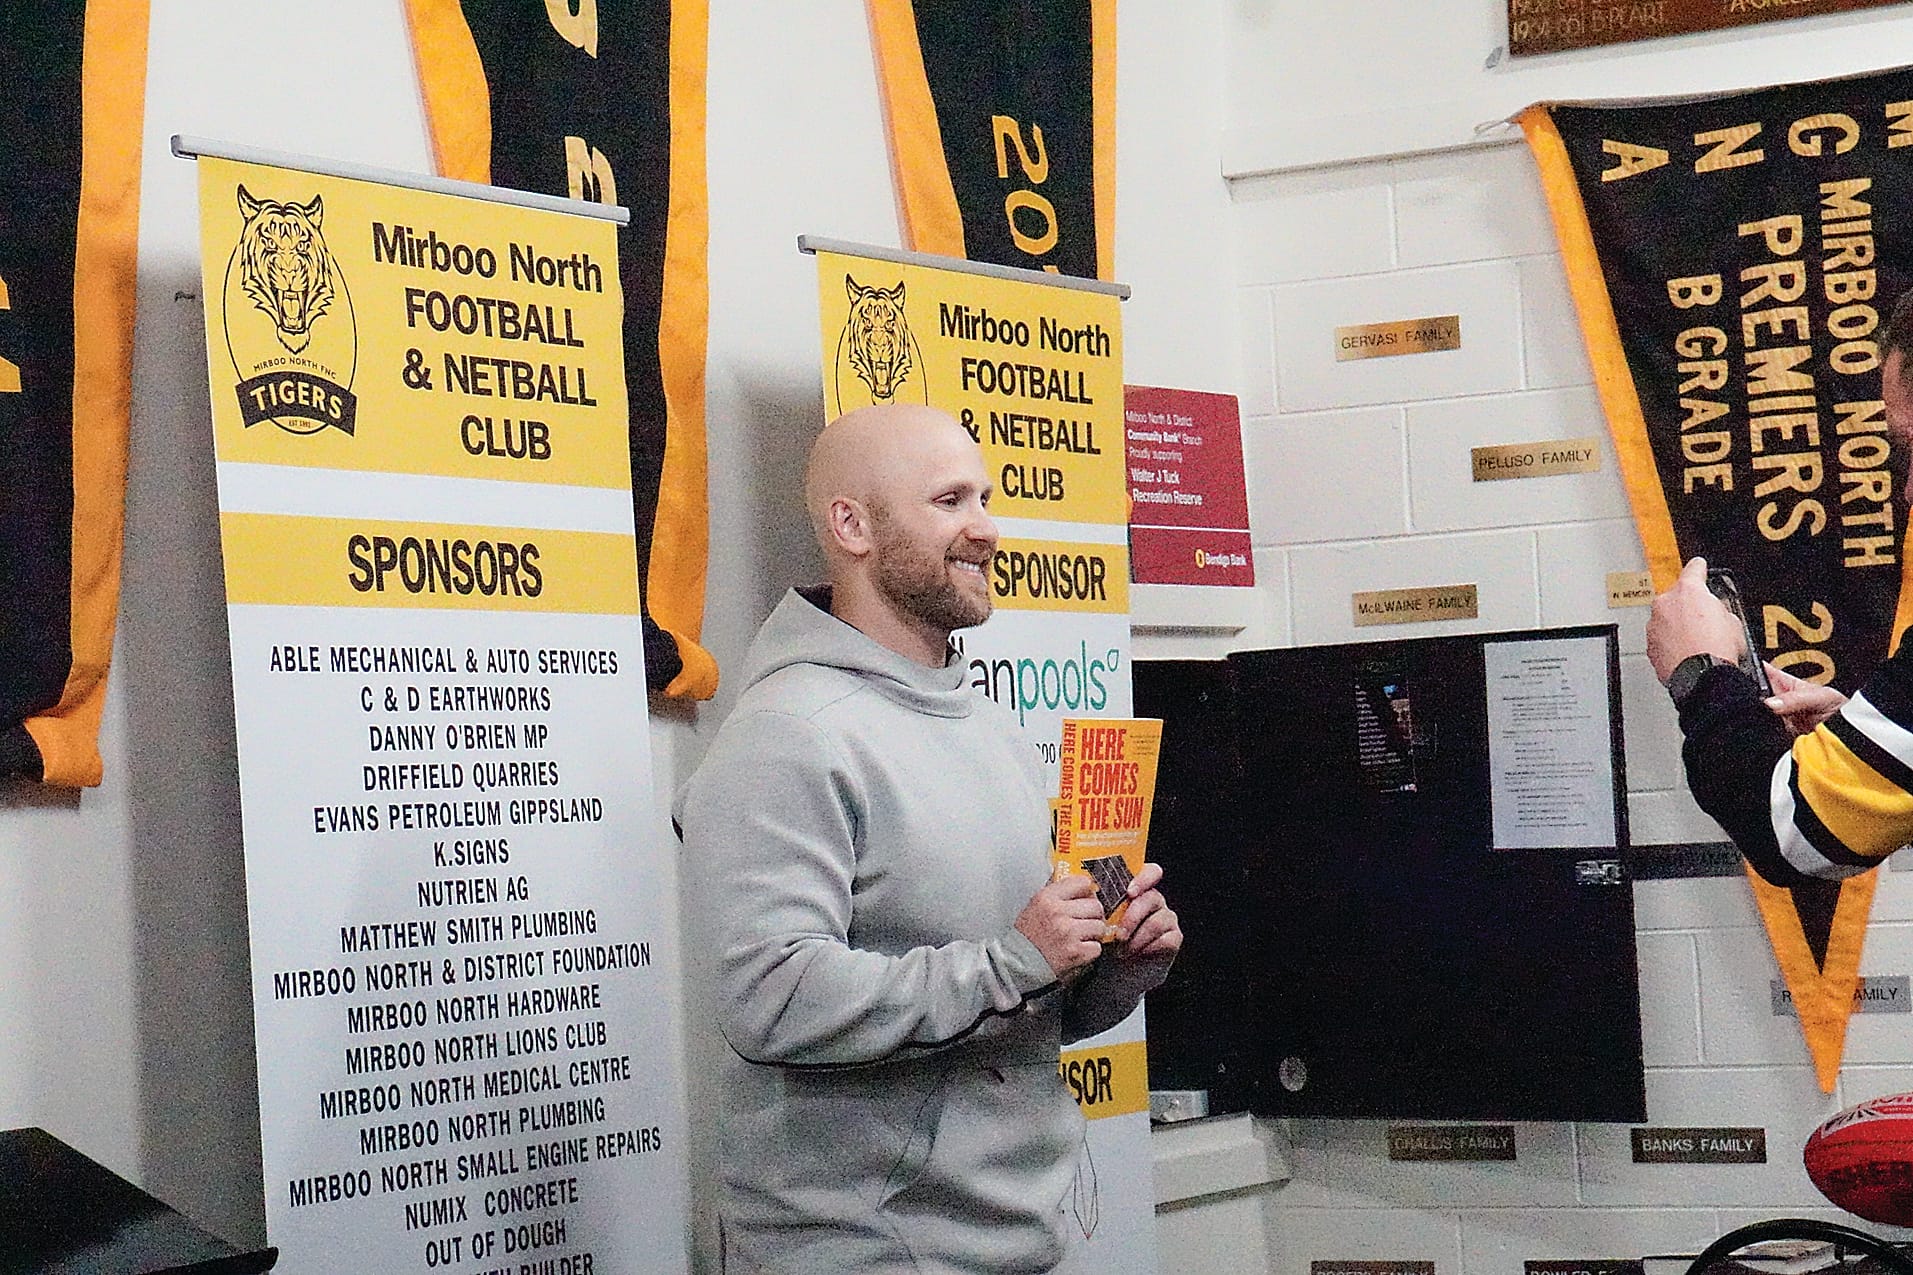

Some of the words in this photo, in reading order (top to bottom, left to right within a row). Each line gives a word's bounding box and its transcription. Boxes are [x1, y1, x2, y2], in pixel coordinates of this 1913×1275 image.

[1694, 122, 1765, 174] N
[1788, 112, 1860, 157] G
[1601, 139, 1670, 183] A
[991, 114, 1061, 273] 20
[372, 221, 498, 279] Mirboo
[510, 242, 603, 293] North
[1818, 178, 1880, 375] MIRBOO
[1667, 273, 1723, 310] B
[405, 287, 584, 348] FOOTBALL
[938, 302, 1030, 348] Mirboo
[1039, 316, 1110, 358] North
[1341, 333, 1398, 350] GERVASI
[1405, 328, 1453, 344] FAMILY
[253, 357, 286, 372] MIRBOO
[290, 357, 318, 370] NORTH
[321, 365, 337, 379] FNC
[402, 348, 433, 390] &
[444, 353, 597, 407] NETBALL
[961, 357, 1093, 405] FOOTBALL
[1737, 215, 1828, 542] PREMIERS
[249, 380, 343, 419] TIGERS
[1674, 326, 1735, 494] GRADE
[460, 415, 551, 460] CLUB
[960, 409, 980, 443] &
[990, 410, 1101, 455] NETBALL
[1127, 429, 1162, 444] Community
[1131, 468, 1154, 484] Walter
[1156, 469, 1162, 482] J
[1164, 470, 1180, 485] Tuck
[1479, 454, 1534, 470] PELUSO
[1542, 448, 1593, 466] FAMILY
[1001, 463, 1064, 502] CLUB
[1132, 488, 1173, 504] Recreation
[1174, 490, 1203, 507] Reserve
[1833, 400, 1897, 568] NORTH
[348, 533, 543, 599] SPONSORS
[993, 549, 1107, 601] SPONSOR
[1205, 553, 1230, 567] Bendigo
[1231, 554, 1247, 567] Bank
[1358, 599, 1423, 615] McILWAINE
[1429, 595, 1472, 610] FAMILY
[270, 645, 321, 673] ABLE
[330, 646, 457, 673] MECHANICAL
[466, 649, 479, 673] &
[486, 649, 530, 674] AUTO
[538, 650, 619, 675] SERVICES
[361, 686, 373, 712] C
[384, 686, 399, 712] &
[408, 686, 420, 712] D
[430, 686, 551, 712] EARTHWORKS
[369, 725, 436, 752] DANNY
[446, 725, 517, 751] O'BRIEN
[524, 724, 549, 749] MP
[1064, 723, 1077, 756] HERE
[1081, 728, 1127, 761] HERE
[363, 763, 464, 792] DRIFFIELD
[473, 761, 560, 790] QUARRIES
[1061, 758, 1077, 800] COMES
[1079, 762, 1139, 796] COMES
[313, 806, 379, 834] EVANS
[389, 800, 502, 831] PETROLEUM
[509, 798, 603, 826] GIPPSLAND
[1059, 803, 1073, 826] THE
[1078, 798, 1109, 830] THE
[1113, 797, 1145, 830] SUN
[433, 838, 510, 867] K.SIGNS
[1058, 829, 1071, 854] SUN
[418, 878, 498, 908] NUTRIEN
[506, 876, 530, 901] AG
[340, 920, 437, 954] MATTHEW
[447, 916, 503, 944] SMITH
[512, 909, 597, 940] PLUMBING
[273, 967, 356, 1000] MIRBOO
[366, 960, 433, 992] NORTH
[442, 960, 456, 986] &
[465, 950, 545, 983] DISTRICT
[552, 942, 651, 975] FOUNDATION
[347, 1001, 427, 1034] MIRBOO
[436, 995, 499, 1025] NORTH
[507, 984, 600, 1016] HARDWARE
[346, 1041, 426, 1075] MIRBOO
[434, 1033, 498, 1065] NORTH
[506, 1028, 558, 1056] LIONS
[565, 1023, 608, 1050] CLUB
[320, 1084, 401, 1120] MIRBOO
[410, 1076, 476, 1109] NORTH
[484, 1063, 562, 1099] MEDICAL
[569, 1055, 631, 1088] CENTRE
[360, 1120, 439, 1155] MIRBOO
[448, 1109, 511, 1143] NORTH
[519, 1097, 606, 1134] PLUMBING
[1460, 1136, 1509, 1148] FAMILY
[1642, 1138, 1693, 1151] BANKS
[1700, 1138, 1753, 1151] FAMILY
[289, 1169, 371, 1208] MIRBOO
[381, 1159, 448, 1194] NORTH
[457, 1148, 519, 1181] SMALL
[527, 1136, 589, 1171] ENGINE
[596, 1127, 661, 1159] REPAIRS
[405, 1195, 468, 1231] NUMIX
[484, 1178, 579, 1218] CONCRETE
[426, 1235, 463, 1268] OUT
[472, 1231, 496, 1260] OF
[504, 1218, 567, 1254] DOUGH
